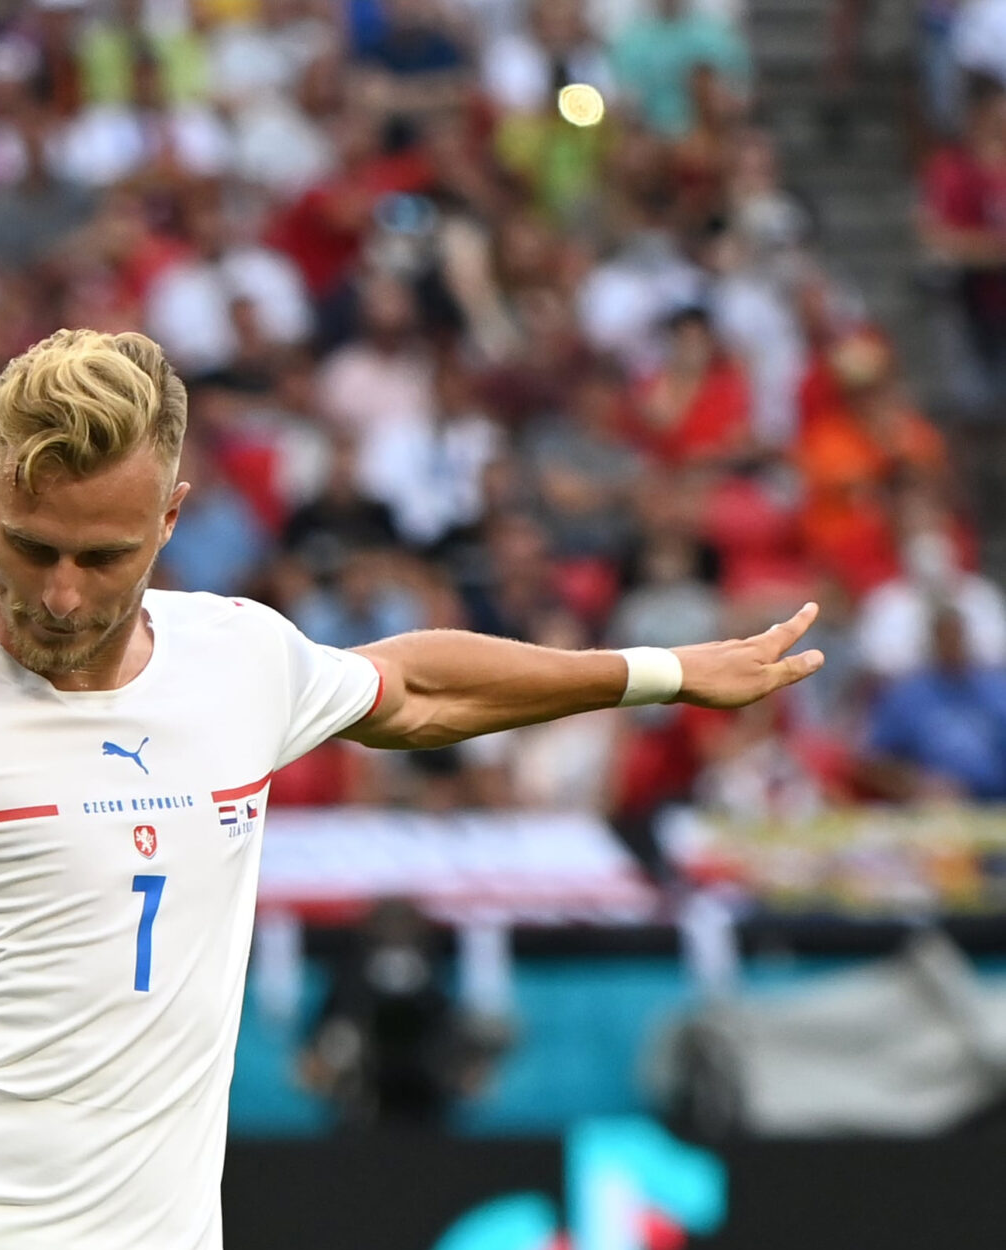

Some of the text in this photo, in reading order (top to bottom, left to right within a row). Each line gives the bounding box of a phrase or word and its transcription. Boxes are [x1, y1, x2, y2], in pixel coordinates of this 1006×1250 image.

[83, 795, 193, 814] CZECH REPUBLIC
[131, 874, 167, 992] 7
